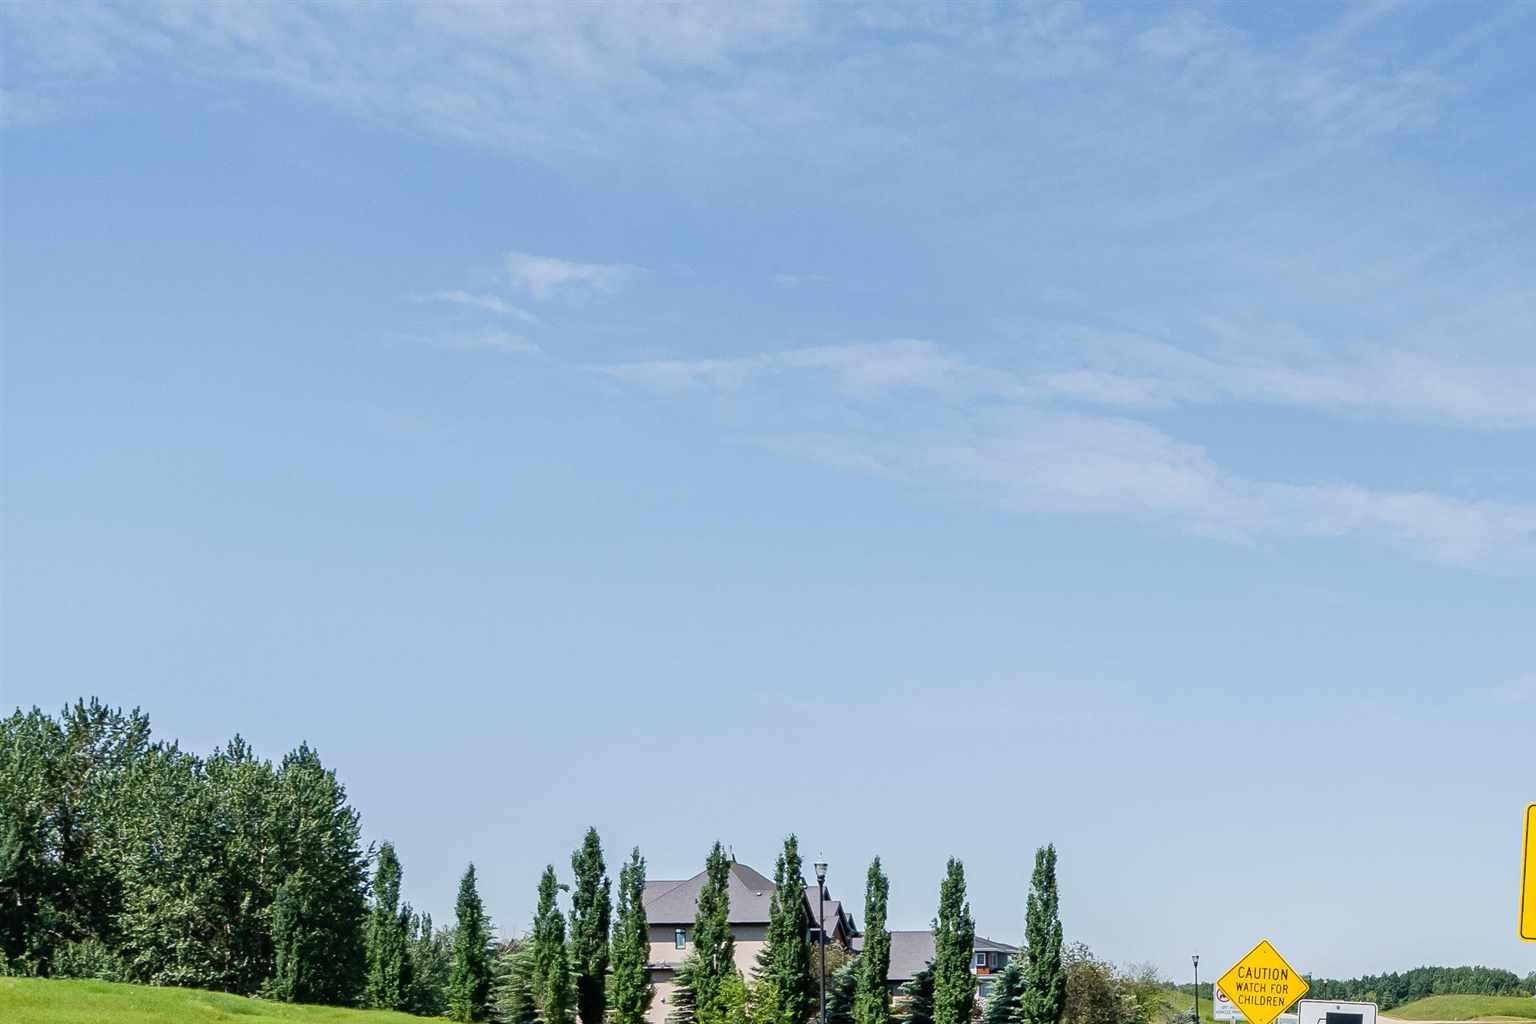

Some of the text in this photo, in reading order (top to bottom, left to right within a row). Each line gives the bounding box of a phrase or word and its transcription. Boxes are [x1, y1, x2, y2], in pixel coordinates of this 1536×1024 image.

[1237, 966, 1288, 981] CAUTION
[1235, 982, 1288, 994] WATCH FOR
[1237, 995, 1284, 1007] CHILDREN
